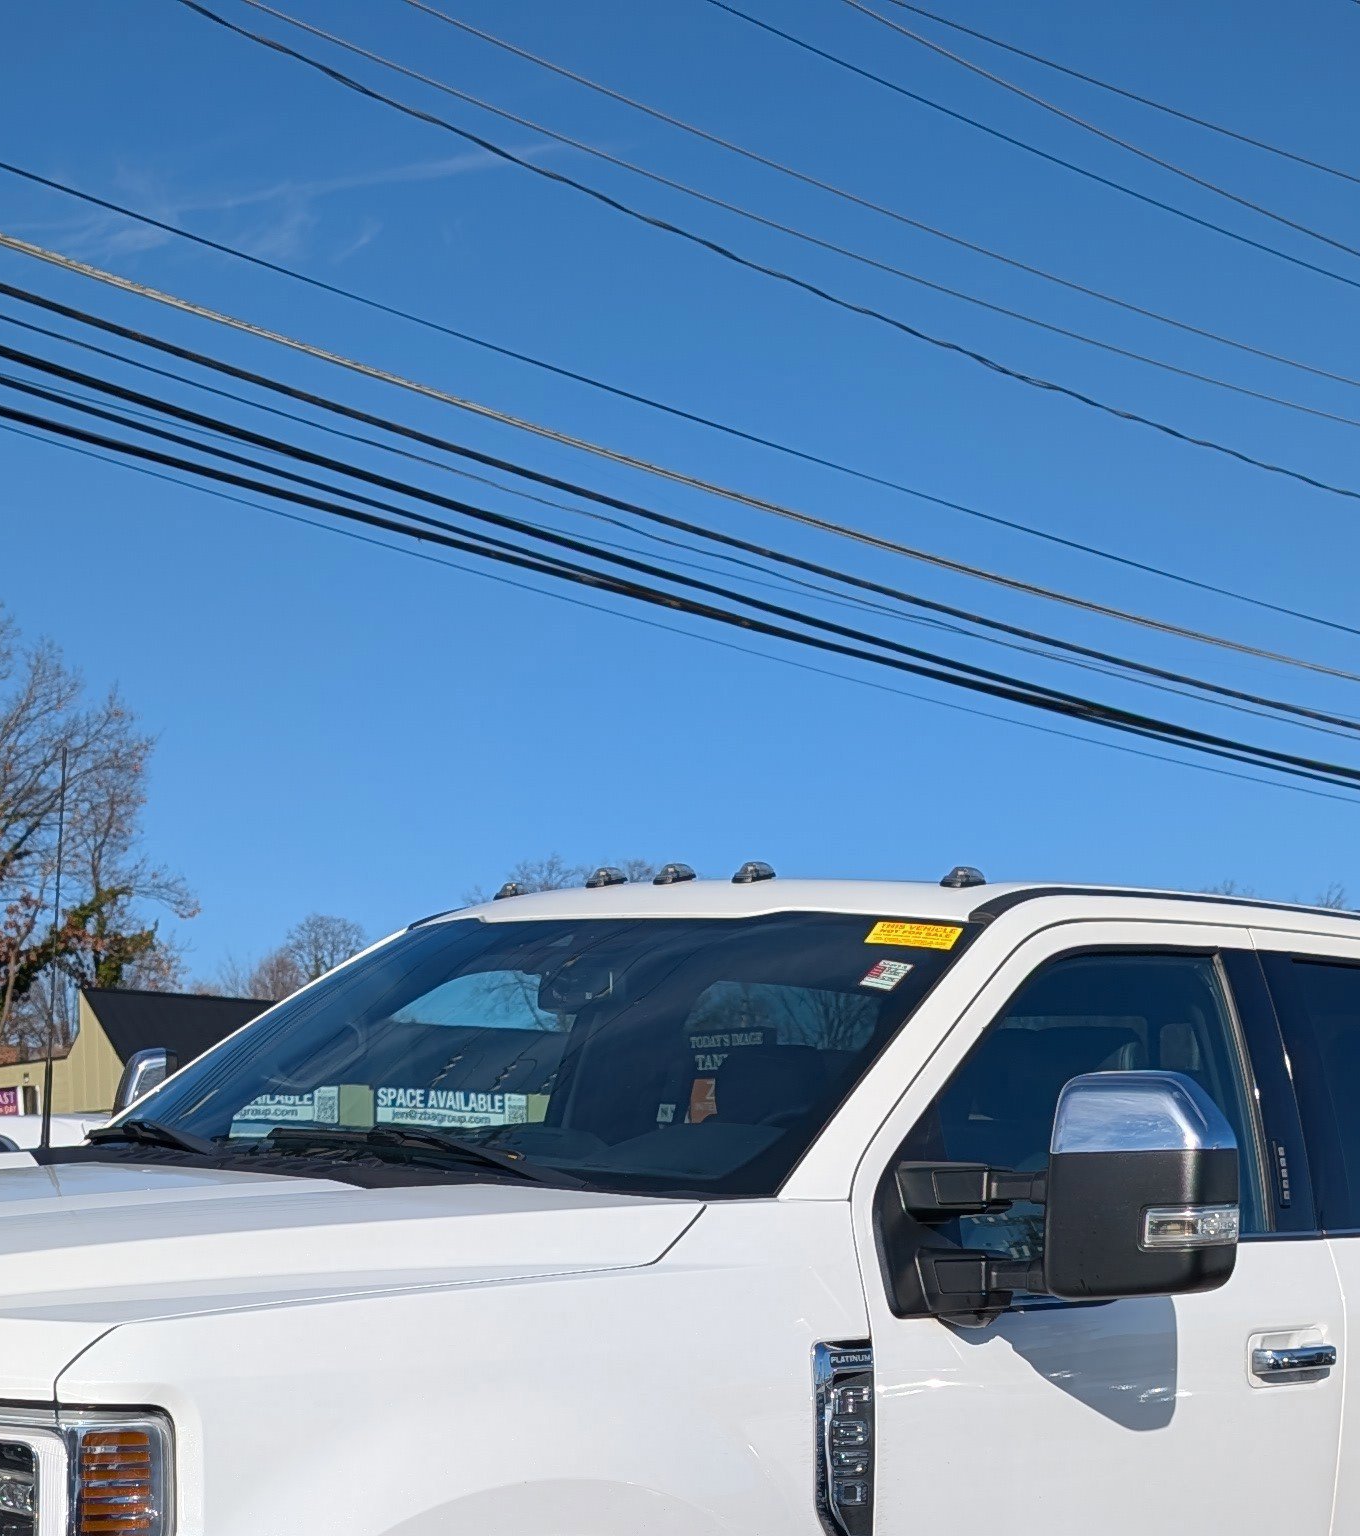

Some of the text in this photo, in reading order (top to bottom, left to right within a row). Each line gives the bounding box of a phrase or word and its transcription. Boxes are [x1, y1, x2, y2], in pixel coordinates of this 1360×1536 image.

[909, 925, 957, 935] VEHICLE
[689, 1032, 764, 1049] TODAY'S IMAGE
[695, 1054, 728, 1070] TAN
[252, 1094, 313, 1105] AILABLE
[377, 1088, 504, 1112] SPACE AVAILABLE
[241, 1107, 299, 1119] group.com
[830, 1354, 871, 1364] PLATINUM
